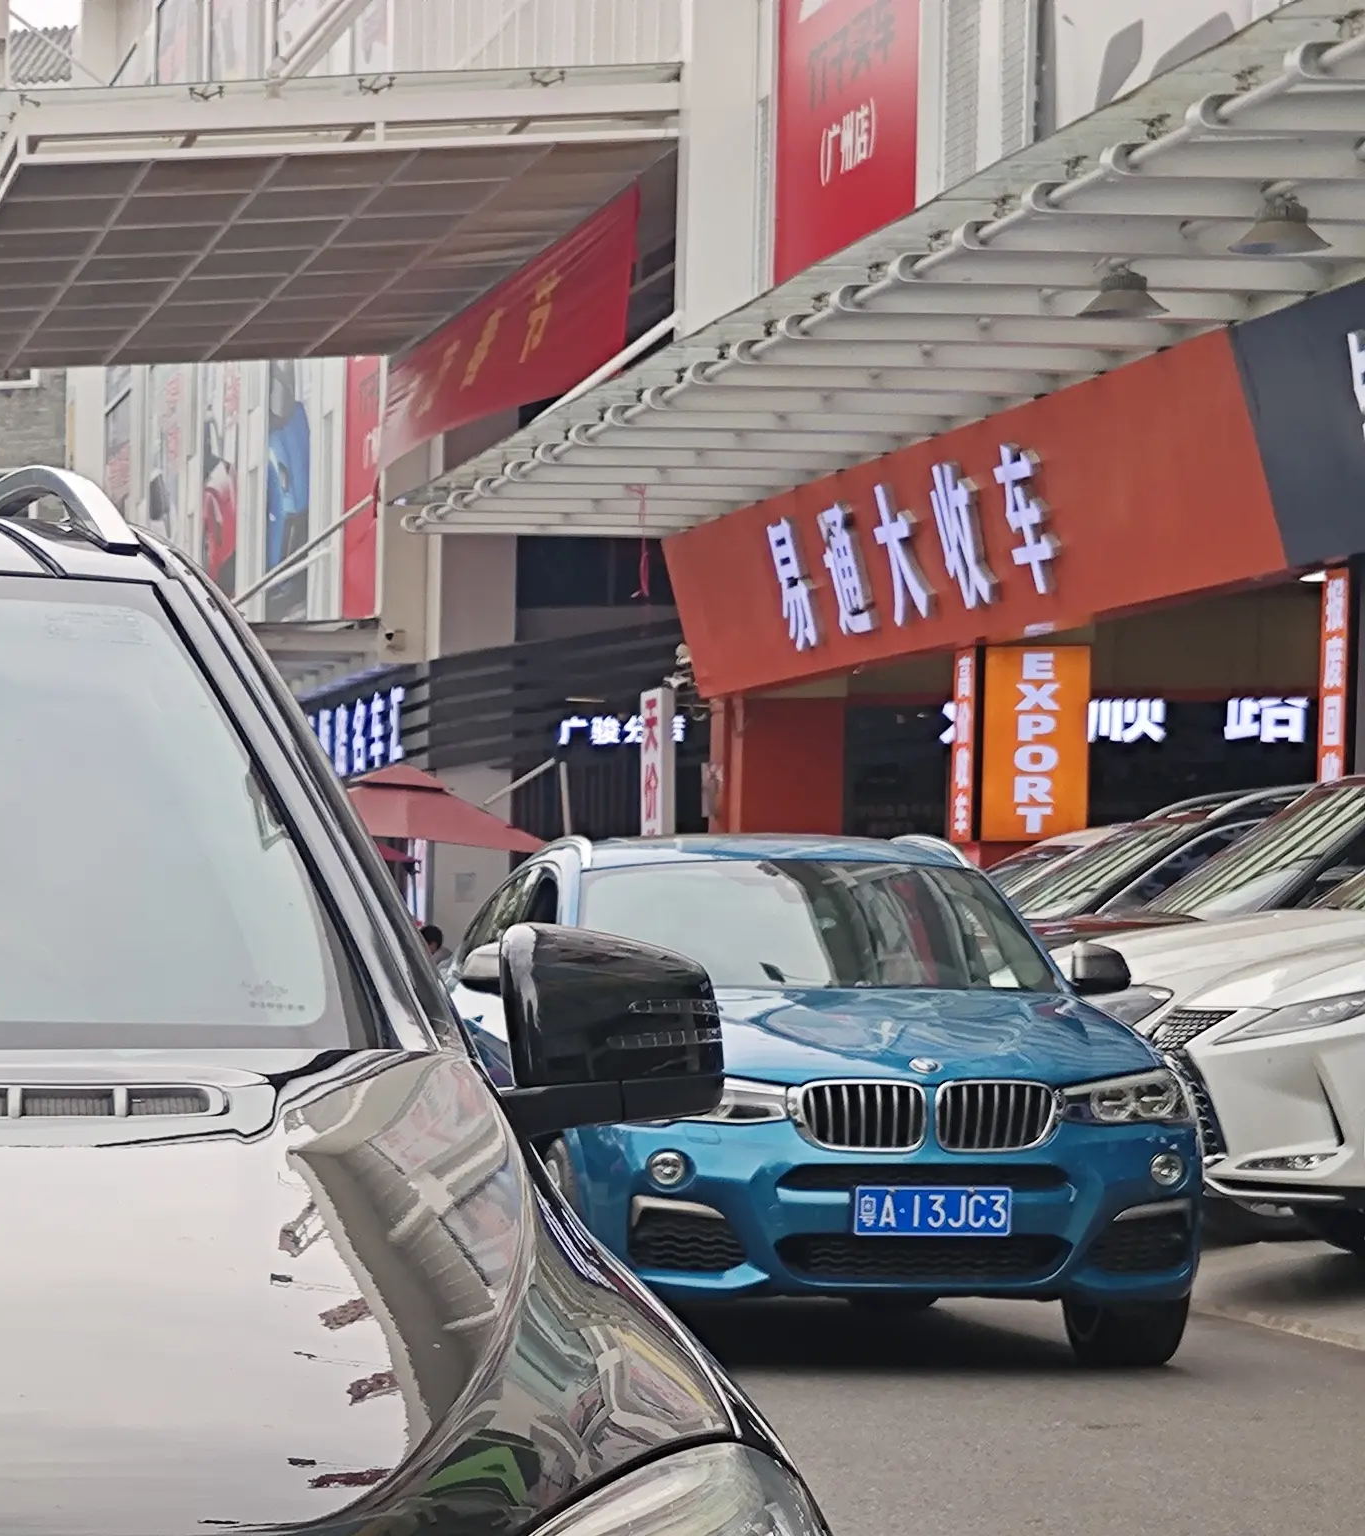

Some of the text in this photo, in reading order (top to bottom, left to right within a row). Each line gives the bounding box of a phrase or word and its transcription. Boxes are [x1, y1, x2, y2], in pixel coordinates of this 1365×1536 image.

[766, 442, 1062, 652] 易通大收车
[1013, 652, 1061, 834] EXPORT
